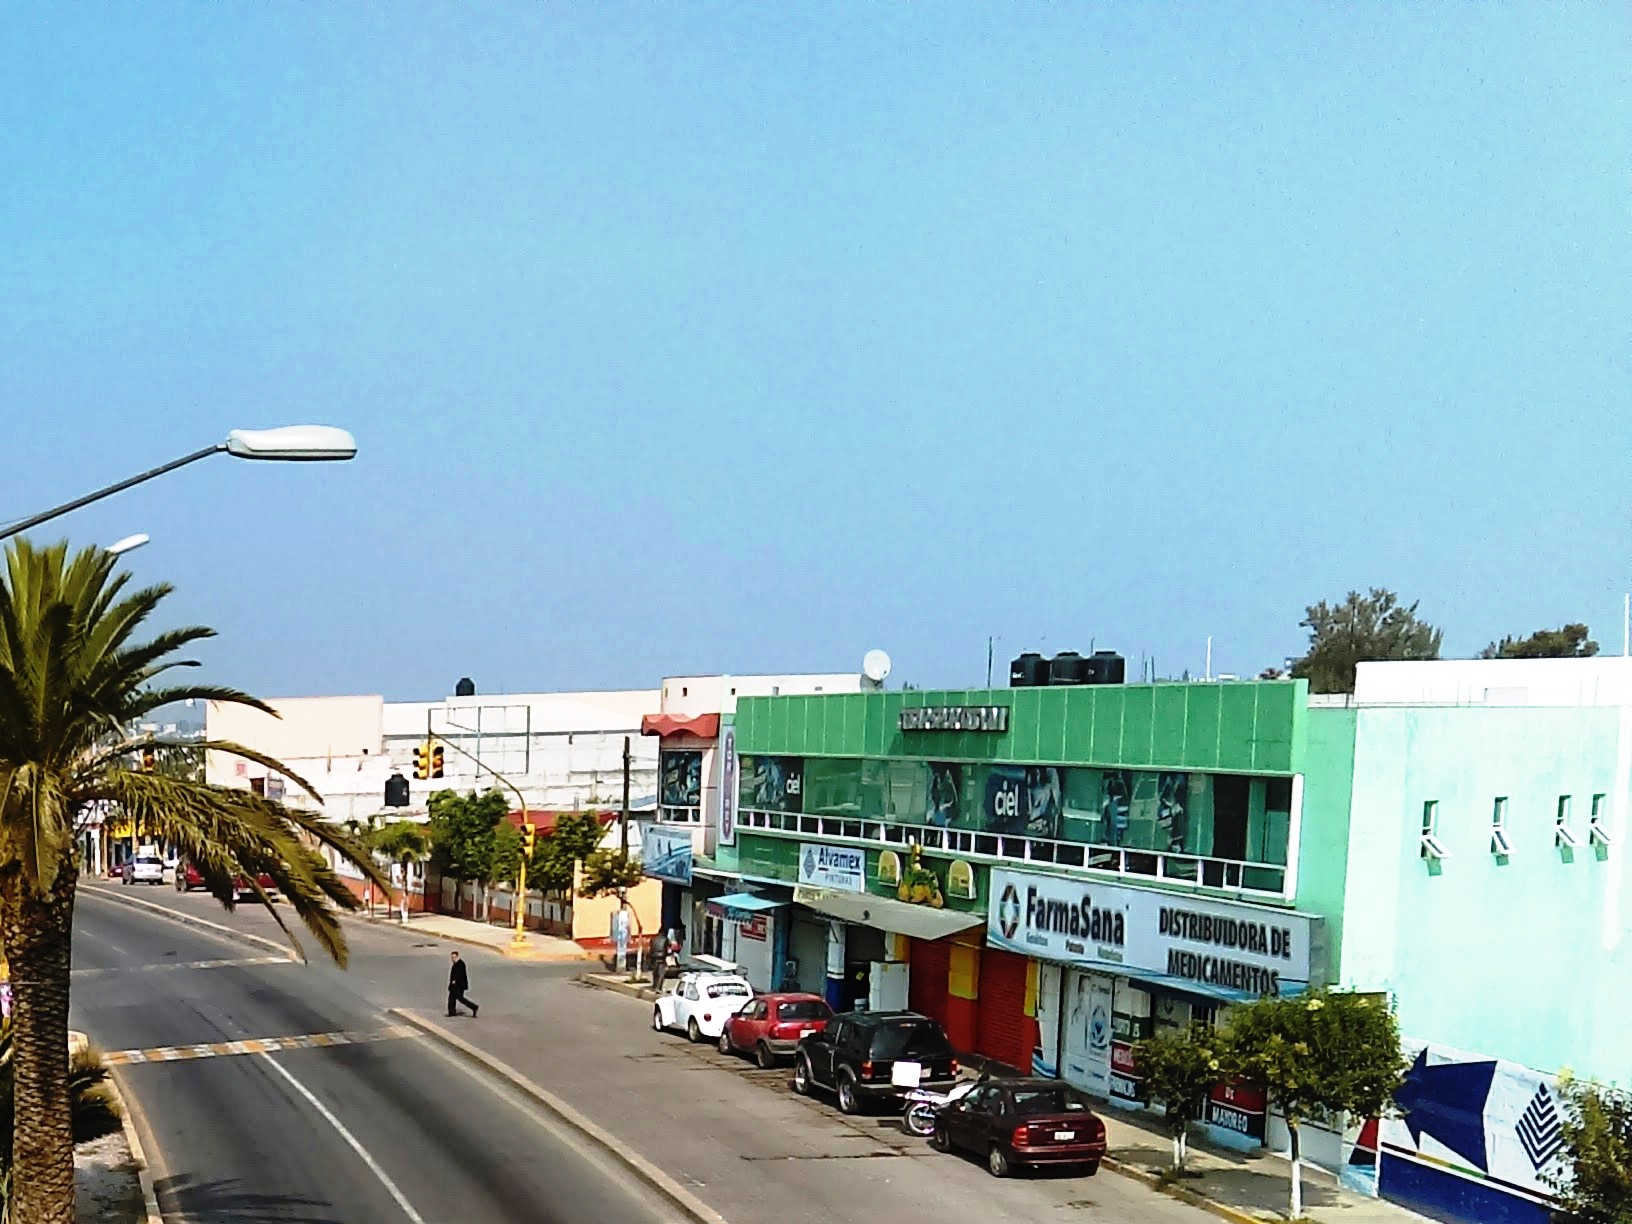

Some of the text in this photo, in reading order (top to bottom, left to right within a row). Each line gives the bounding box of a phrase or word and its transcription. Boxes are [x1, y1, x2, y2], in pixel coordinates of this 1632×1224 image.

[786, 772, 801, 795] ciel
[995, 780, 1019, 817] ciel
[818, 847, 862, 870] Alvamex
[1026, 885, 1125, 946] FarmaSana
[1159, 906, 1291, 960] DISTRIBUIDORA DE
[1167, 948, 1280, 998] MEDICAMENTOS
